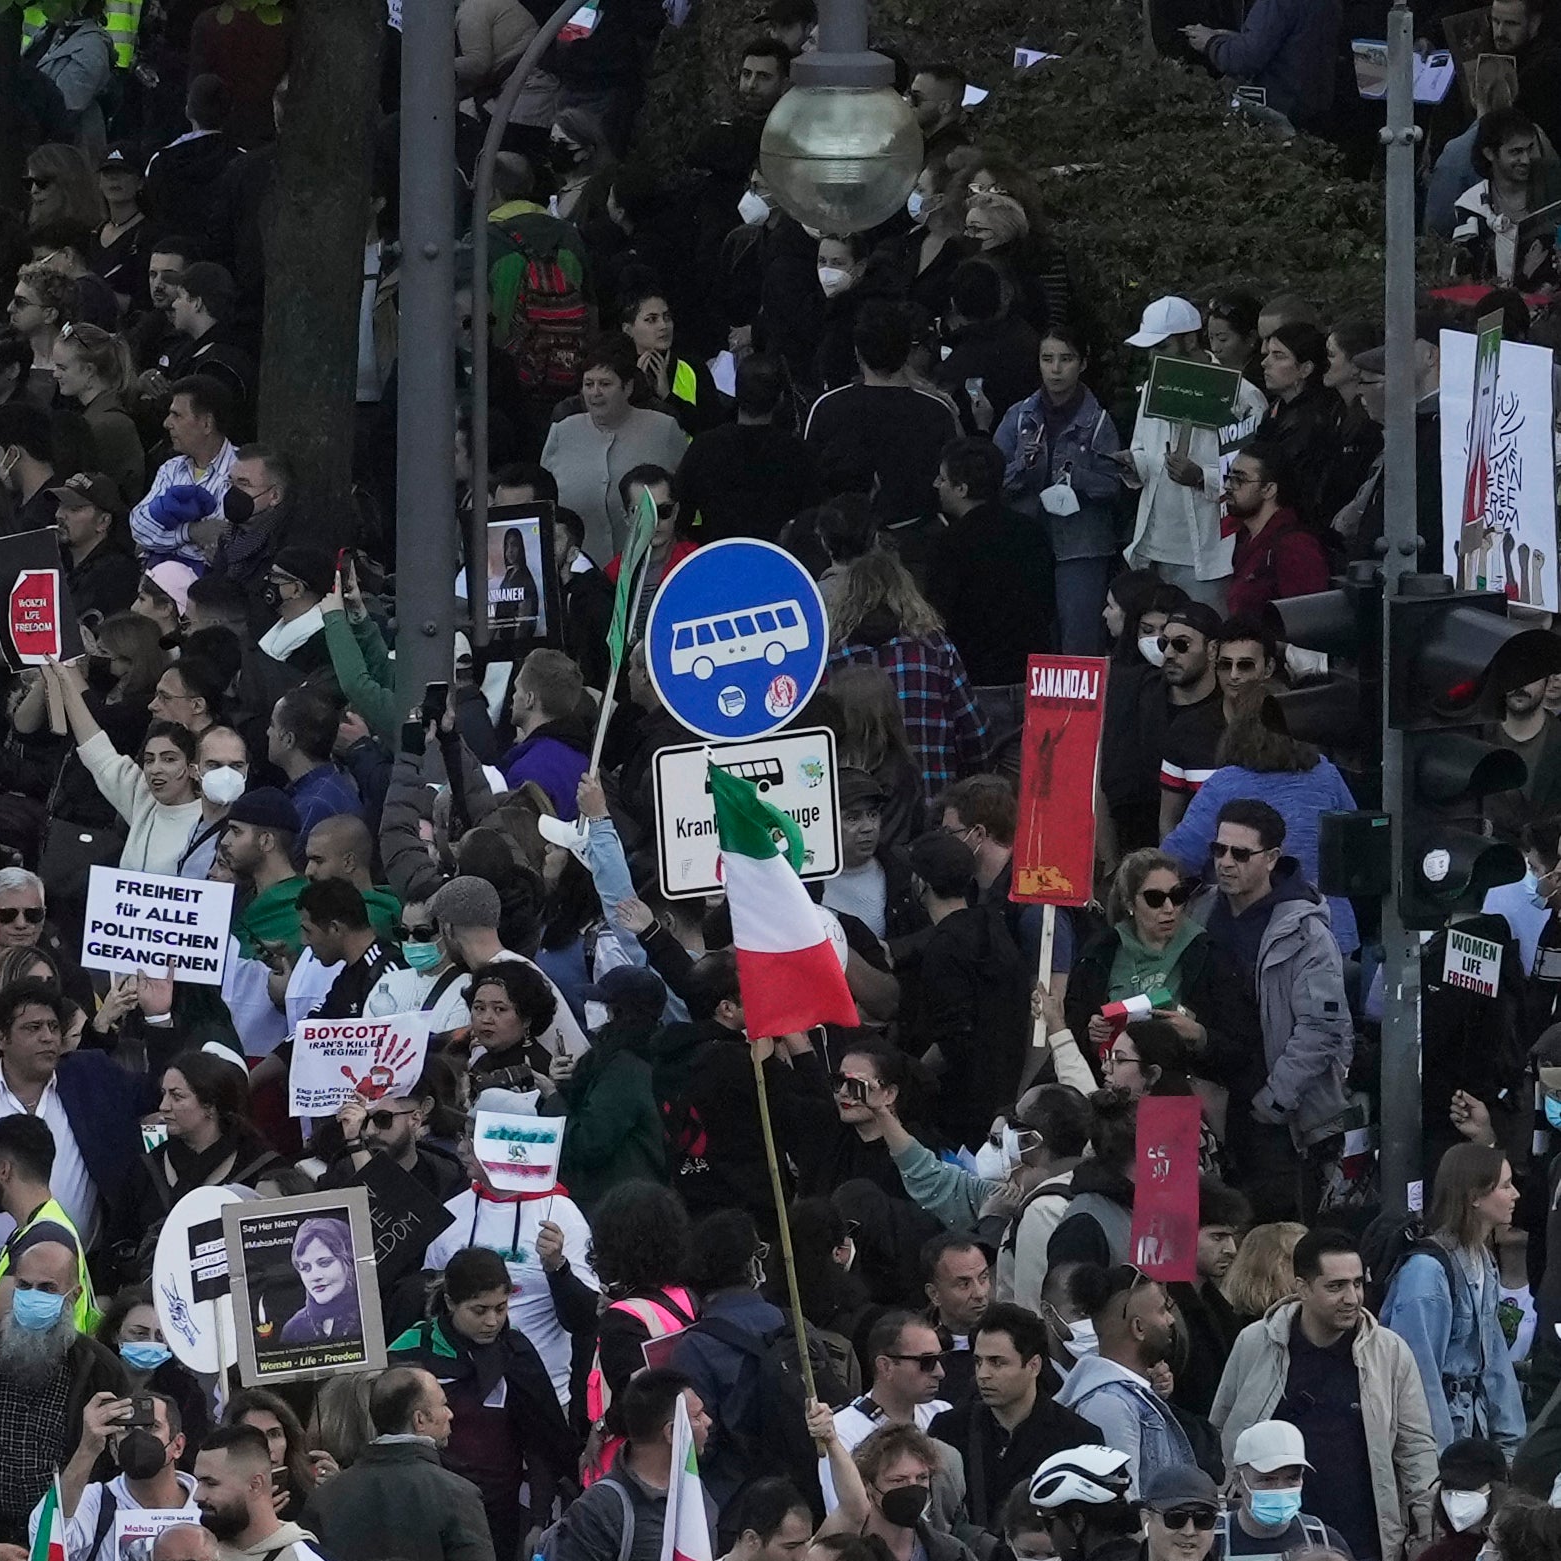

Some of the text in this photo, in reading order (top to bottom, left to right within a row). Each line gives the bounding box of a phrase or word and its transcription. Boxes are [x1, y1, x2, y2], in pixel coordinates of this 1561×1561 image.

[1029, 667, 1101, 700] SANANDAJ
[115, 879, 203, 904] FREIHEIT
[116, 902, 199, 926] für ALLE
[90, 920, 219, 951] POLITISCHEN
[86, 941, 218, 973] GEFANGENEN
[1450, 932, 1498, 962] WOMEN
[1462, 956, 1482, 976] LIFE
[1447, 969, 1495, 997] FREEDOM
[304, 1024, 392, 1041] BOYCOTT
[309, 1039, 345, 1050] IRAN'S
[322, 1047, 368, 1058] REGIME!
[242, 1220, 298, 1235] Say Her Name
[243, 1236, 294, 1250] #MahsaAmini
[259, 1350, 362, 1372] Woman Life Freedom
[124, 1524, 154, 1533] Mahsa
